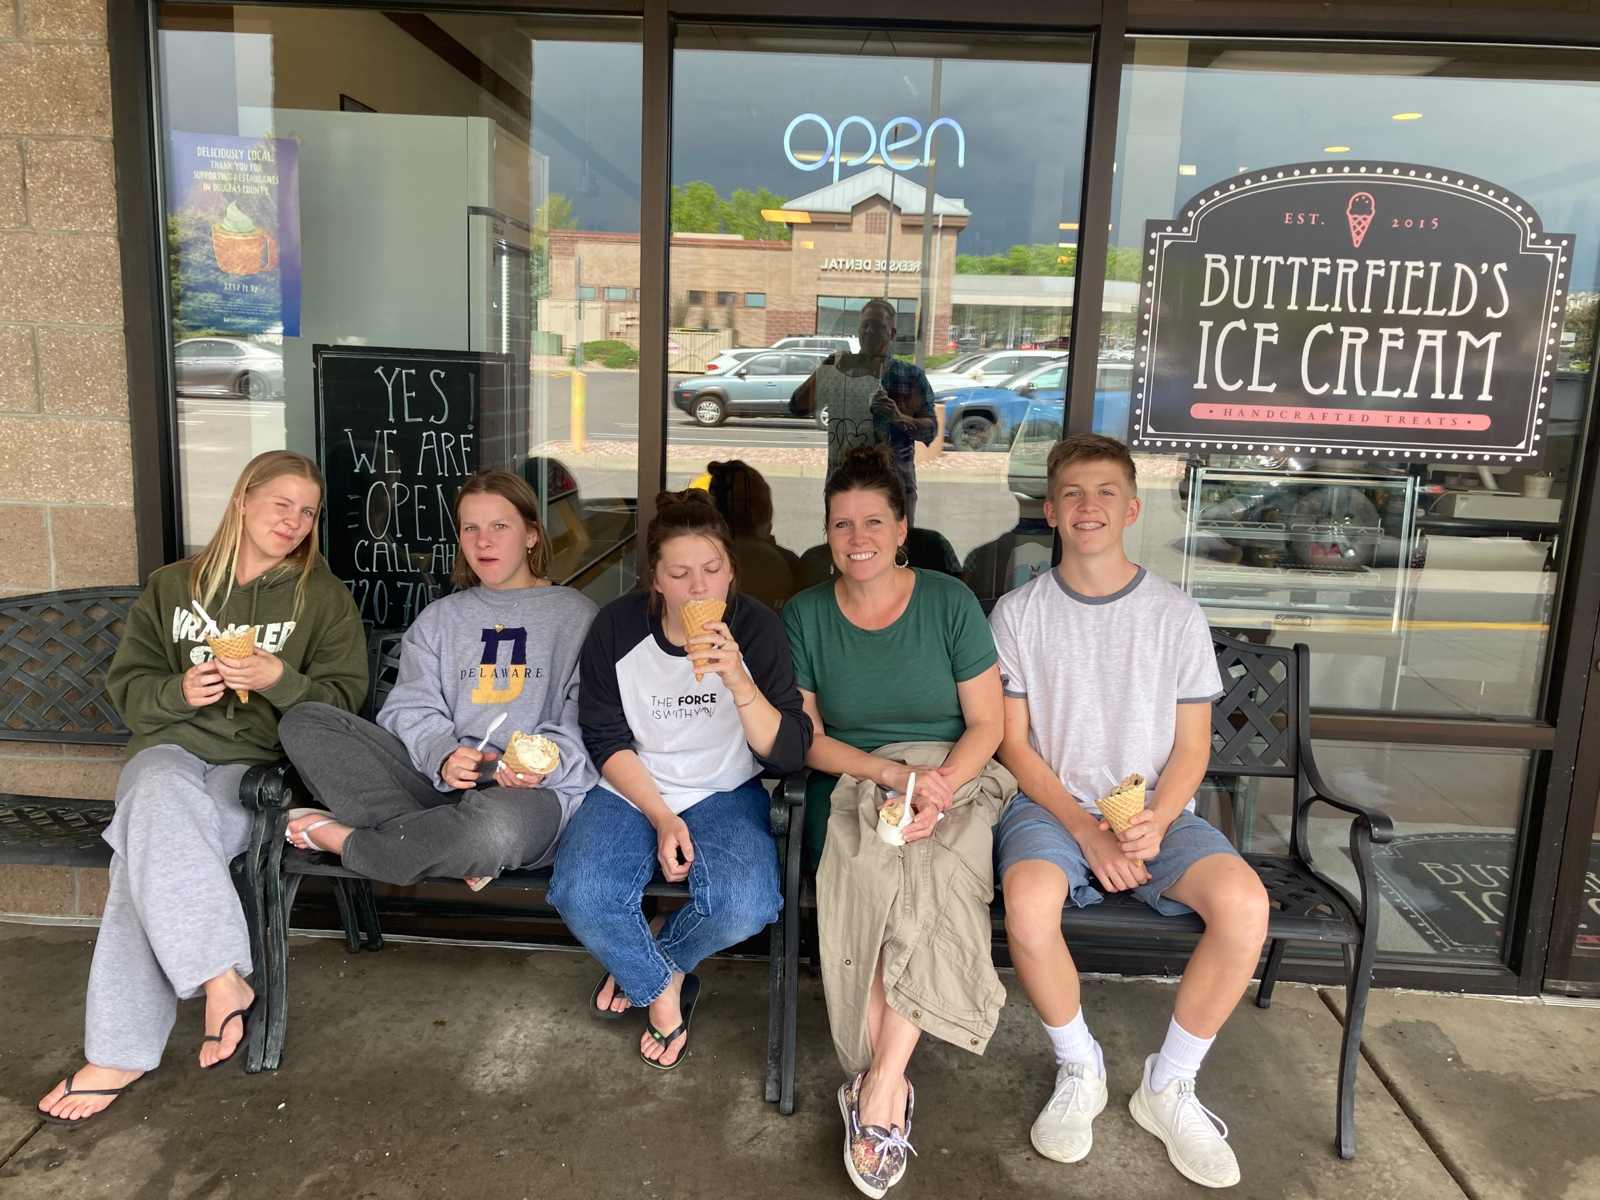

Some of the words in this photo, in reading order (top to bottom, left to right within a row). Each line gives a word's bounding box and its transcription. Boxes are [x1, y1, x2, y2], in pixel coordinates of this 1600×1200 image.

[197, 146, 244, 160] DELICIOUSLY
[247, 150, 275, 162] LOCAL.
[783, 113, 965, 184] open
[210, 160, 233, 170] THANK
[234, 162, 248, 171] YOU
[250, 163, 263, 172] FOR
[193, 170, 232, 181] SUPPORTING
[234, 172, 279, 184] RESTAURANTS
[203, 182, 211, 191] IN
[212, 182, 240, 193] DOUGLAS
[1284, 212, 1325, 226] EST.
[1391, 217, 1440, 230] 2015
[1200, 253, 1509, 319] BUTTERFIELD'S
[1193, 319, 1280, 393] ICE
[1301, 322, 1502, 401] CREAM
[1223, 408, 1371, 423] HANDCRAFTED
[1385, 414, 1460, 427] TREATS
[344, 428, 401, 474] WE
[417, 430, 477, 477] ARE
[460, 667, 543, 680] DELAWARE
[651, 695, 673, 708] THE
[678, 693, 717, 706] FORCE
[663, 708, 693, 720] WITH
